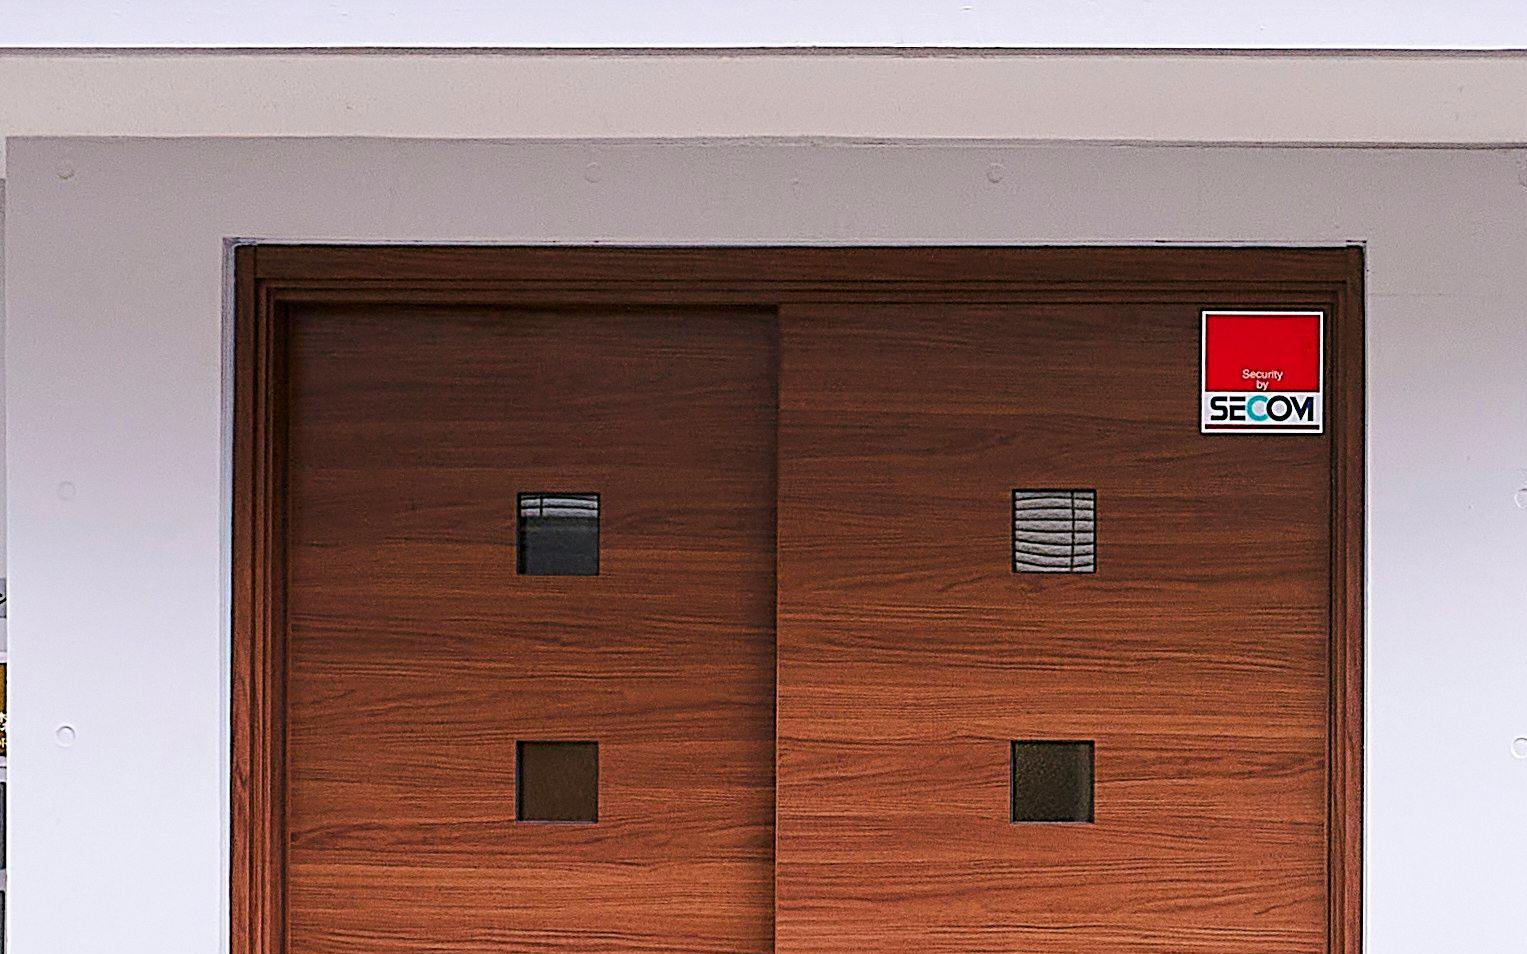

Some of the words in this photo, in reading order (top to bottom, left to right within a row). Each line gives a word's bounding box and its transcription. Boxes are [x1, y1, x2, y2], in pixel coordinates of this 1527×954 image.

[1242, 369, 1283, 381] Security
[1256, 379, 1270, 390] by
[1210, 395, 1314, 421] SECOM
